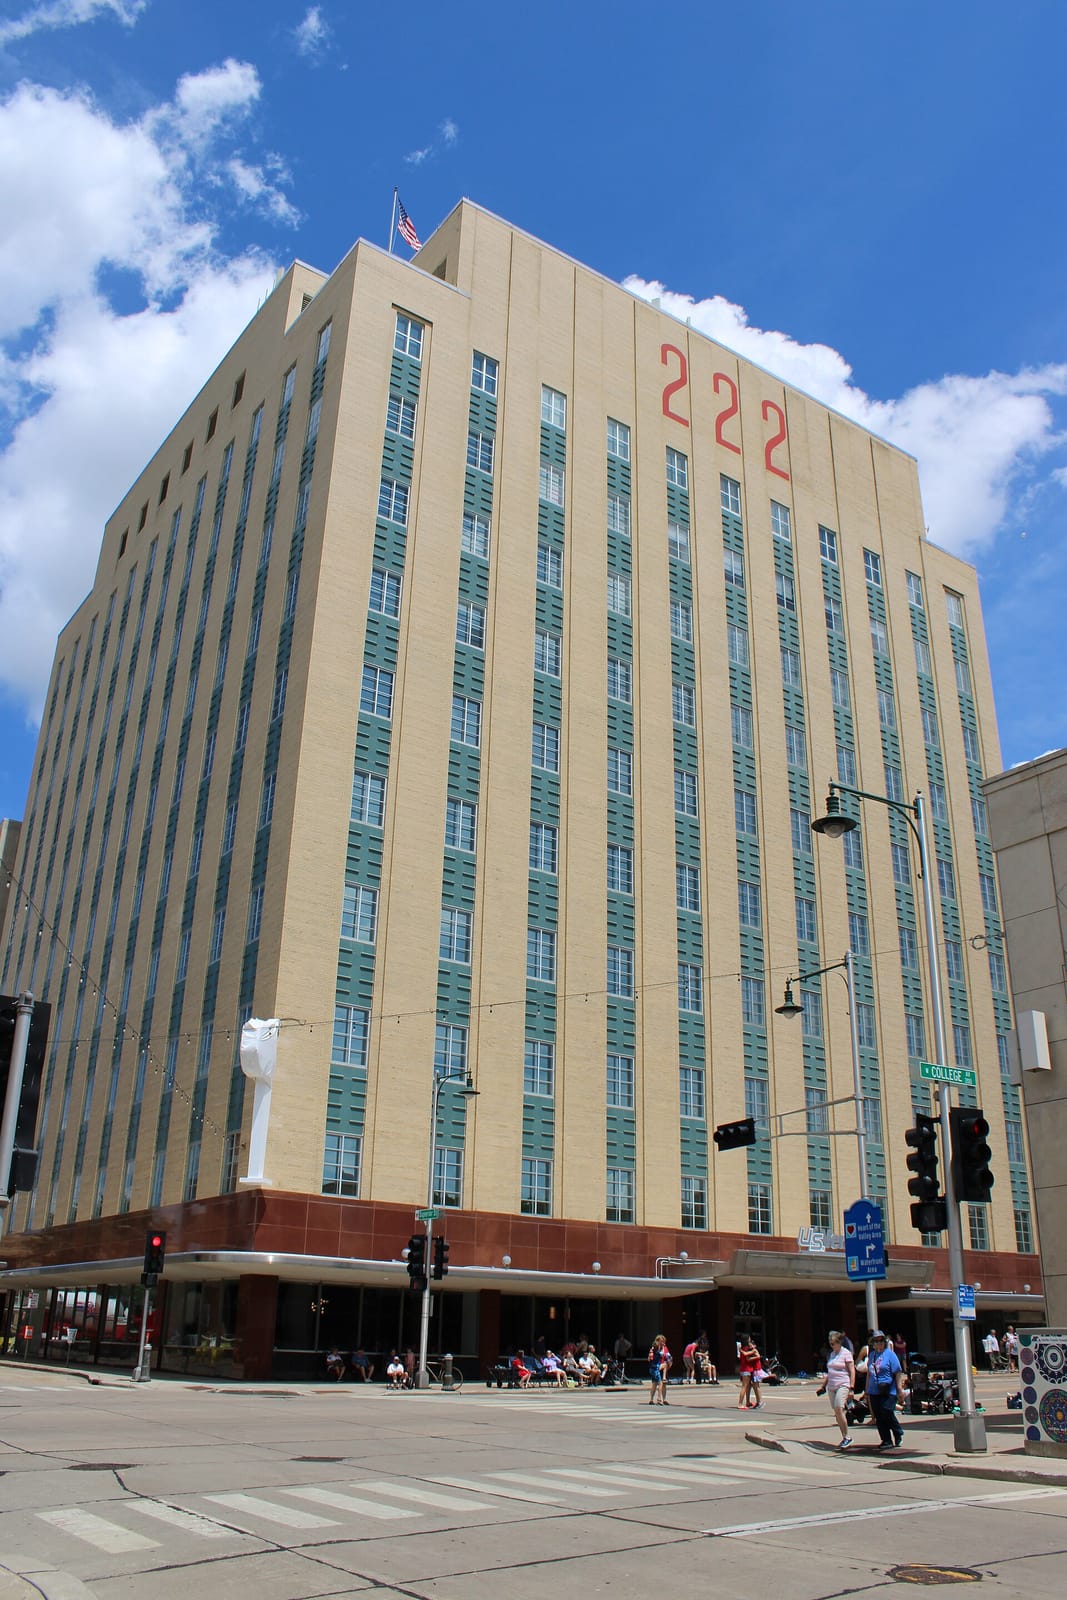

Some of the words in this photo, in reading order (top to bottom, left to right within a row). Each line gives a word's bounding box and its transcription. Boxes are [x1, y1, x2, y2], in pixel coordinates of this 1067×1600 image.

[661, 343, 789, 481] 222
[931, 1066, 963, 1082] COLLEGE
[739, 1301, 756, 1315] 222
